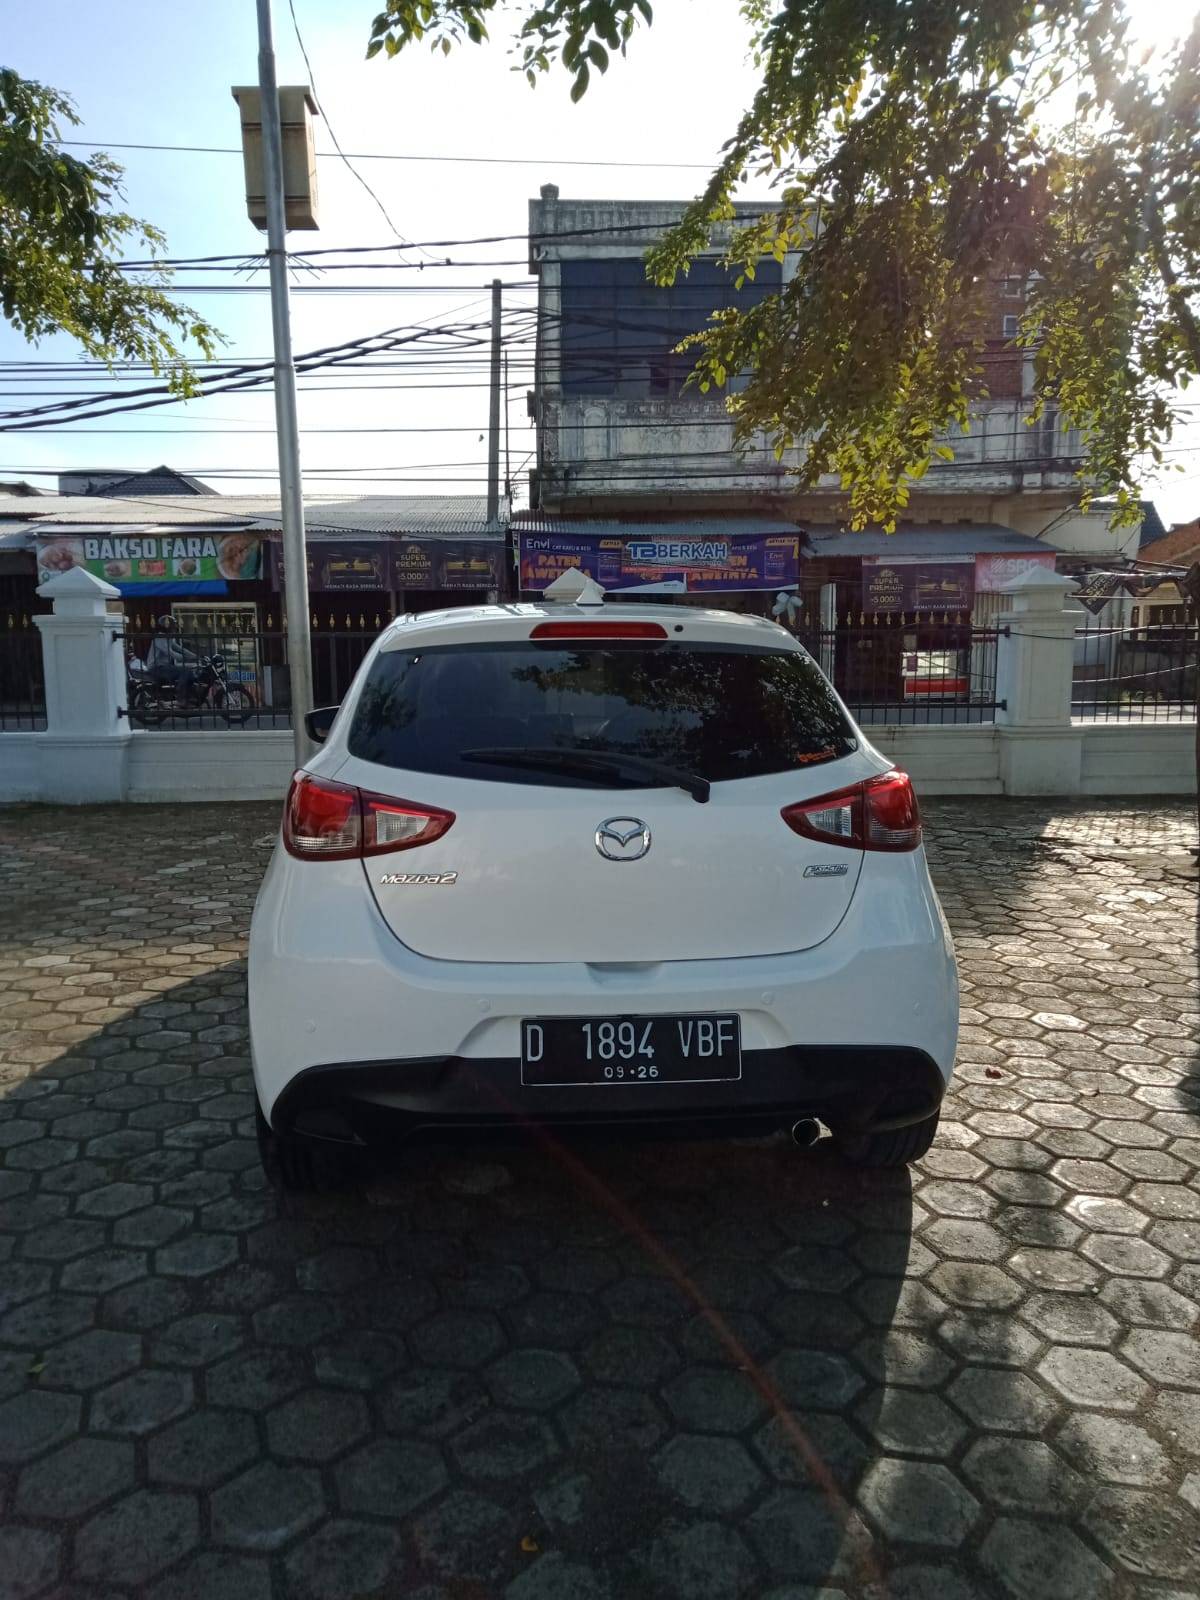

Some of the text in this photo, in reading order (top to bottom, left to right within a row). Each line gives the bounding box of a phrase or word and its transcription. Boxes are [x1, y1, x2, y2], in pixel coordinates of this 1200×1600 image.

[84, 536, 217, 560] BAKSO FARA
[657, 542, 727, 559] BERKAH
[395, 560, 432, 568] PREMIUM
[538, 554, 582, 567] PATEN
[526, 1018, 734, 1062] D 1894 VBF
